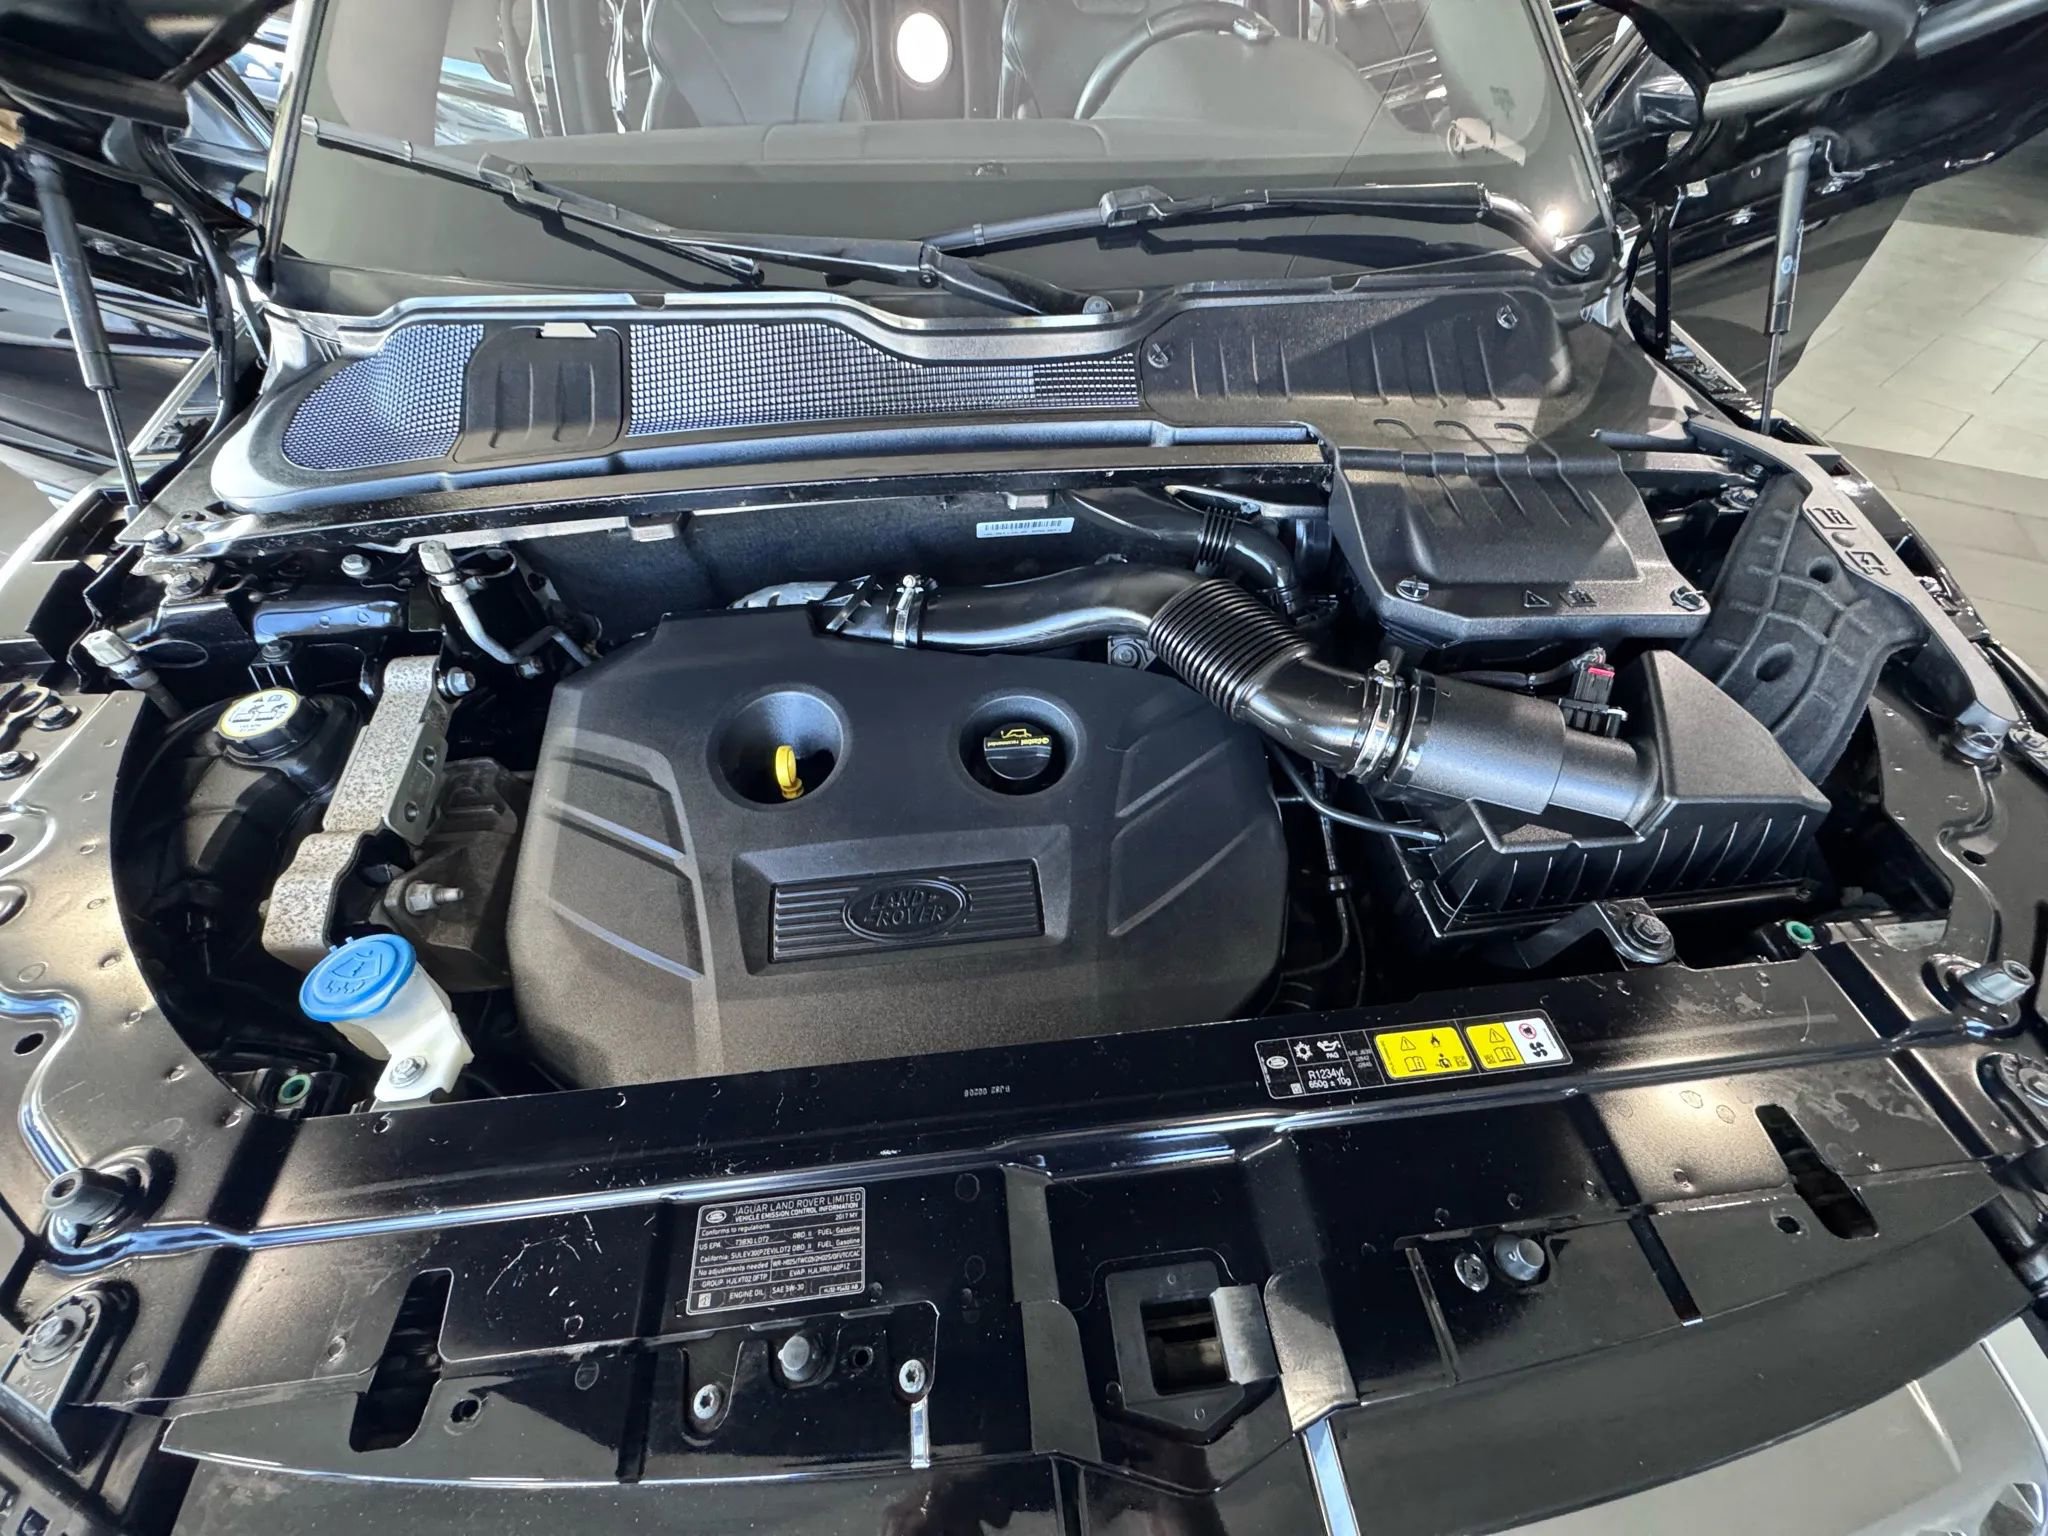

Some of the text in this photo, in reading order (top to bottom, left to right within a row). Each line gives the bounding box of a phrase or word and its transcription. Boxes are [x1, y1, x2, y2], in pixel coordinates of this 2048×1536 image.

[870, 887, 925, 910] LAND
[875, 905, 946, 928] ROVER
[1307, 1067, 1345, 1081] R1234yf
[1308, 1079, 1328, 1089] 650g
[1336, 1076, 1352, 1086] 10g
[733, 1193, 860, 1215] JAGUAR LAND ROVER LIMITED
[735, 1202, 858, 1222] VEHICLE EMISSION CONTROL INFORMATION
[701, 1227, 729, 1236] Conforms
[836, 1225, 860, 1233] Gasoline
[836, 1236, 860, 1246] Gasoline
[698, 1261, 768, 1276] No adjustments needed
[729, 1289, 753, 1299] ENGINE
[772, 1285, 784, 1293] SAE
[785, 1282, 804, 1291] 5W-30
